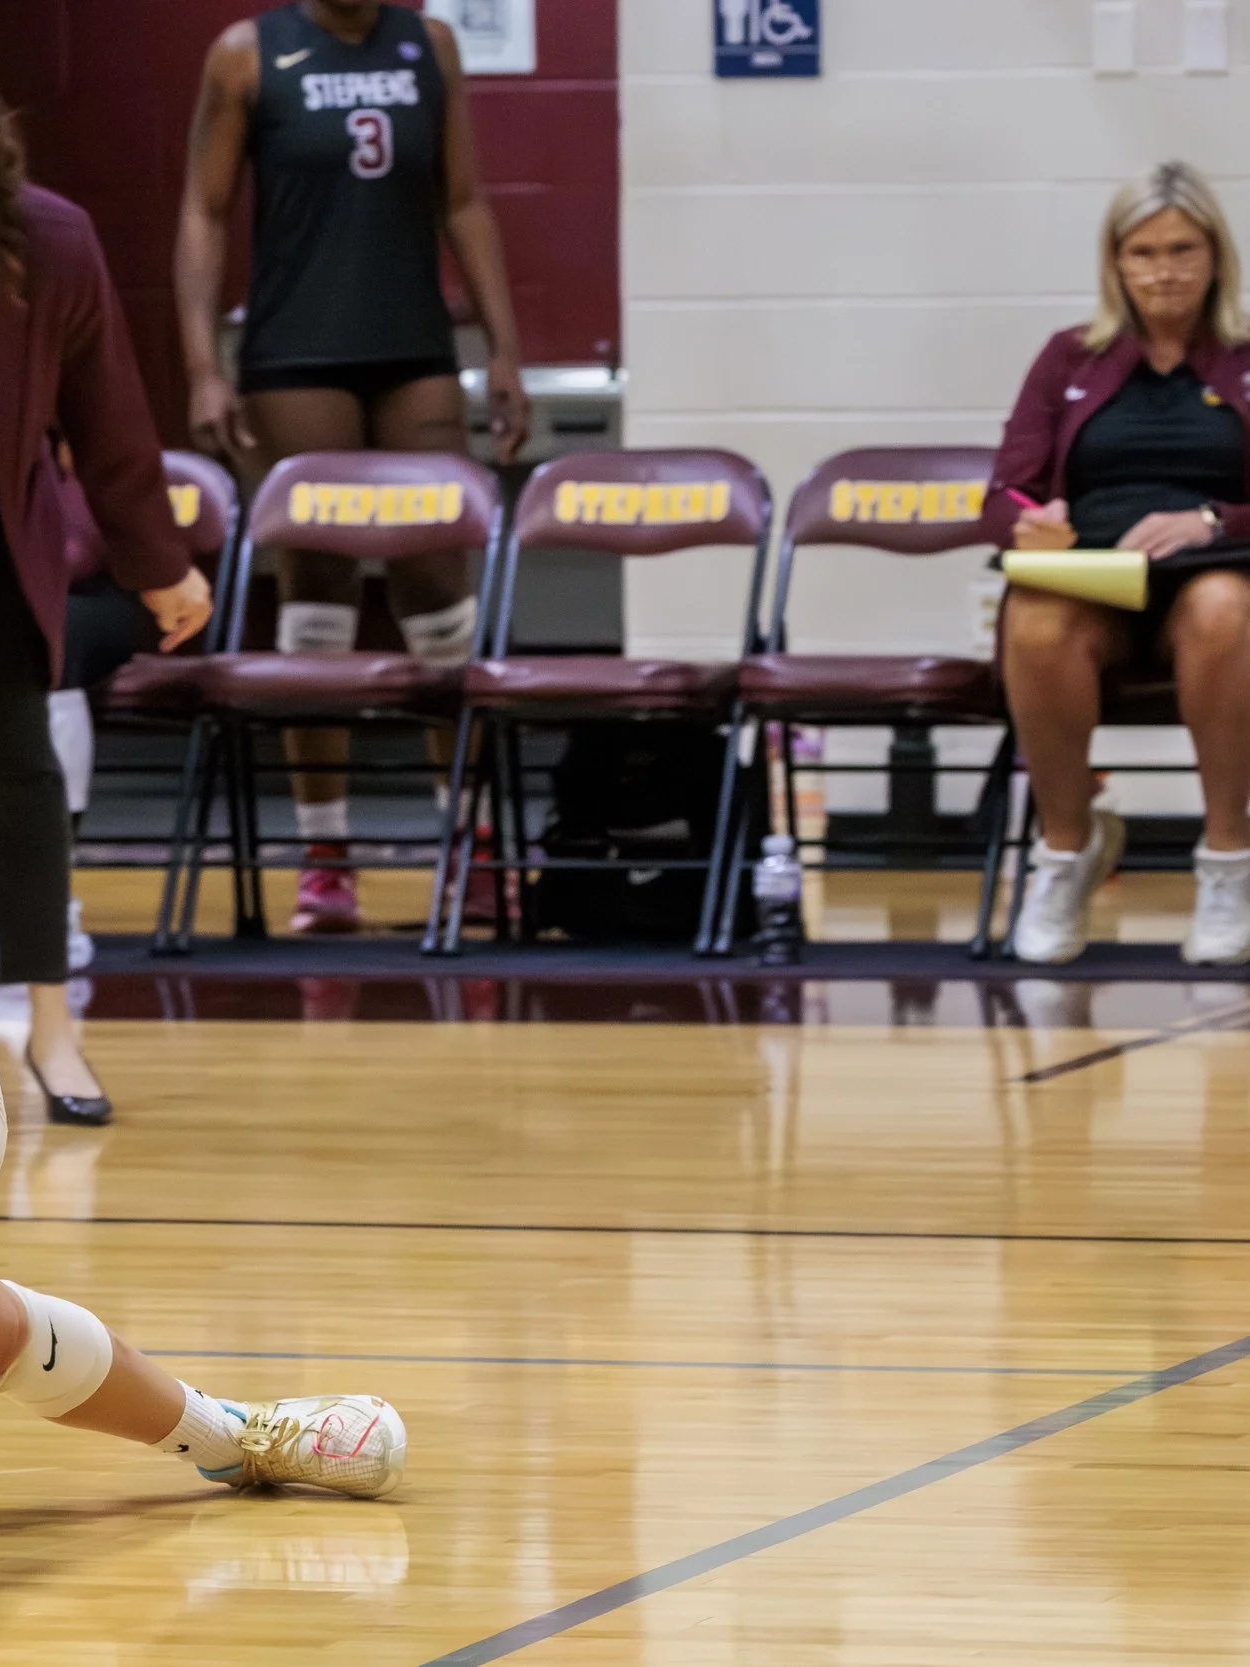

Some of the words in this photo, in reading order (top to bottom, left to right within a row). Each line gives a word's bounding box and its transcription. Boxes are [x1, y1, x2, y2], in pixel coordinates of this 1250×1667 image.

[302, 70, 419, 110] STEPHENS
[346, 108, 395, 180] 3
[830, 479, 989, 524] STEPHEN
